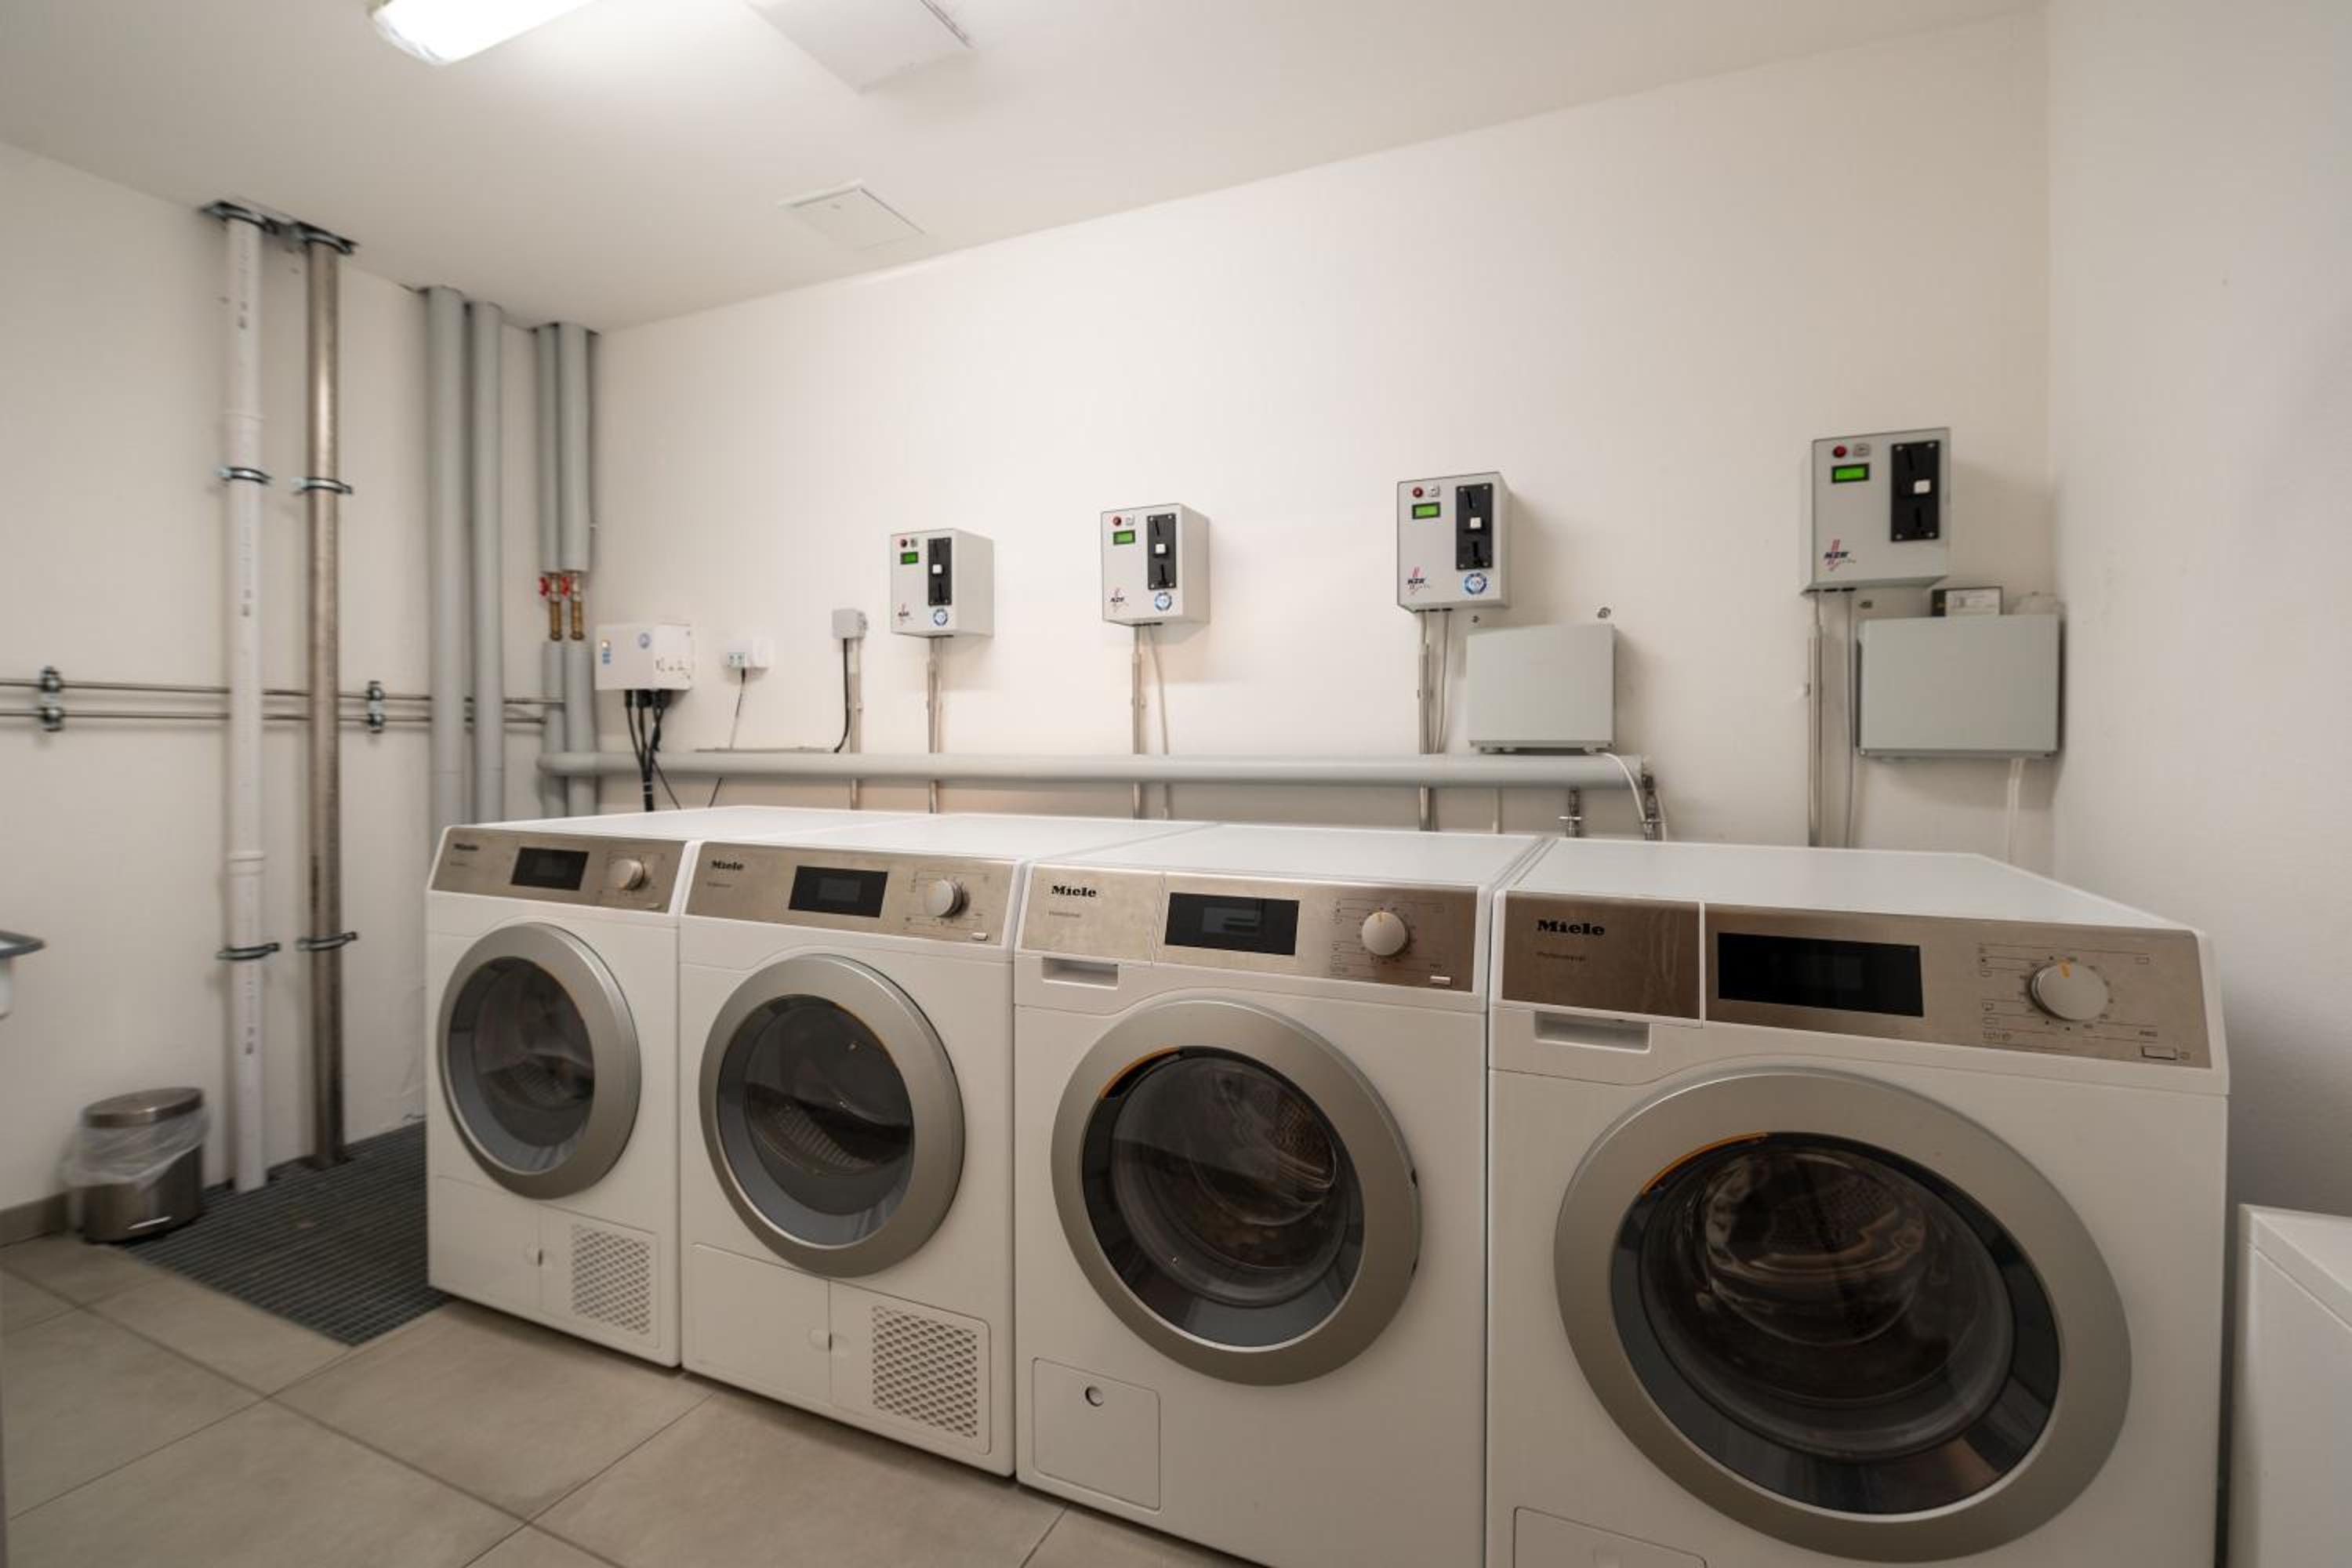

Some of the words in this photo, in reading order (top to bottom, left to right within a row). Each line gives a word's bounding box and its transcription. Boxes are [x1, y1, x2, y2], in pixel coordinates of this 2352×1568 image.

[711, 859, 743, 871] Miele
[1051, 885, 1096, 897] Miele
[1537, 920, 1604, 935] Miele
